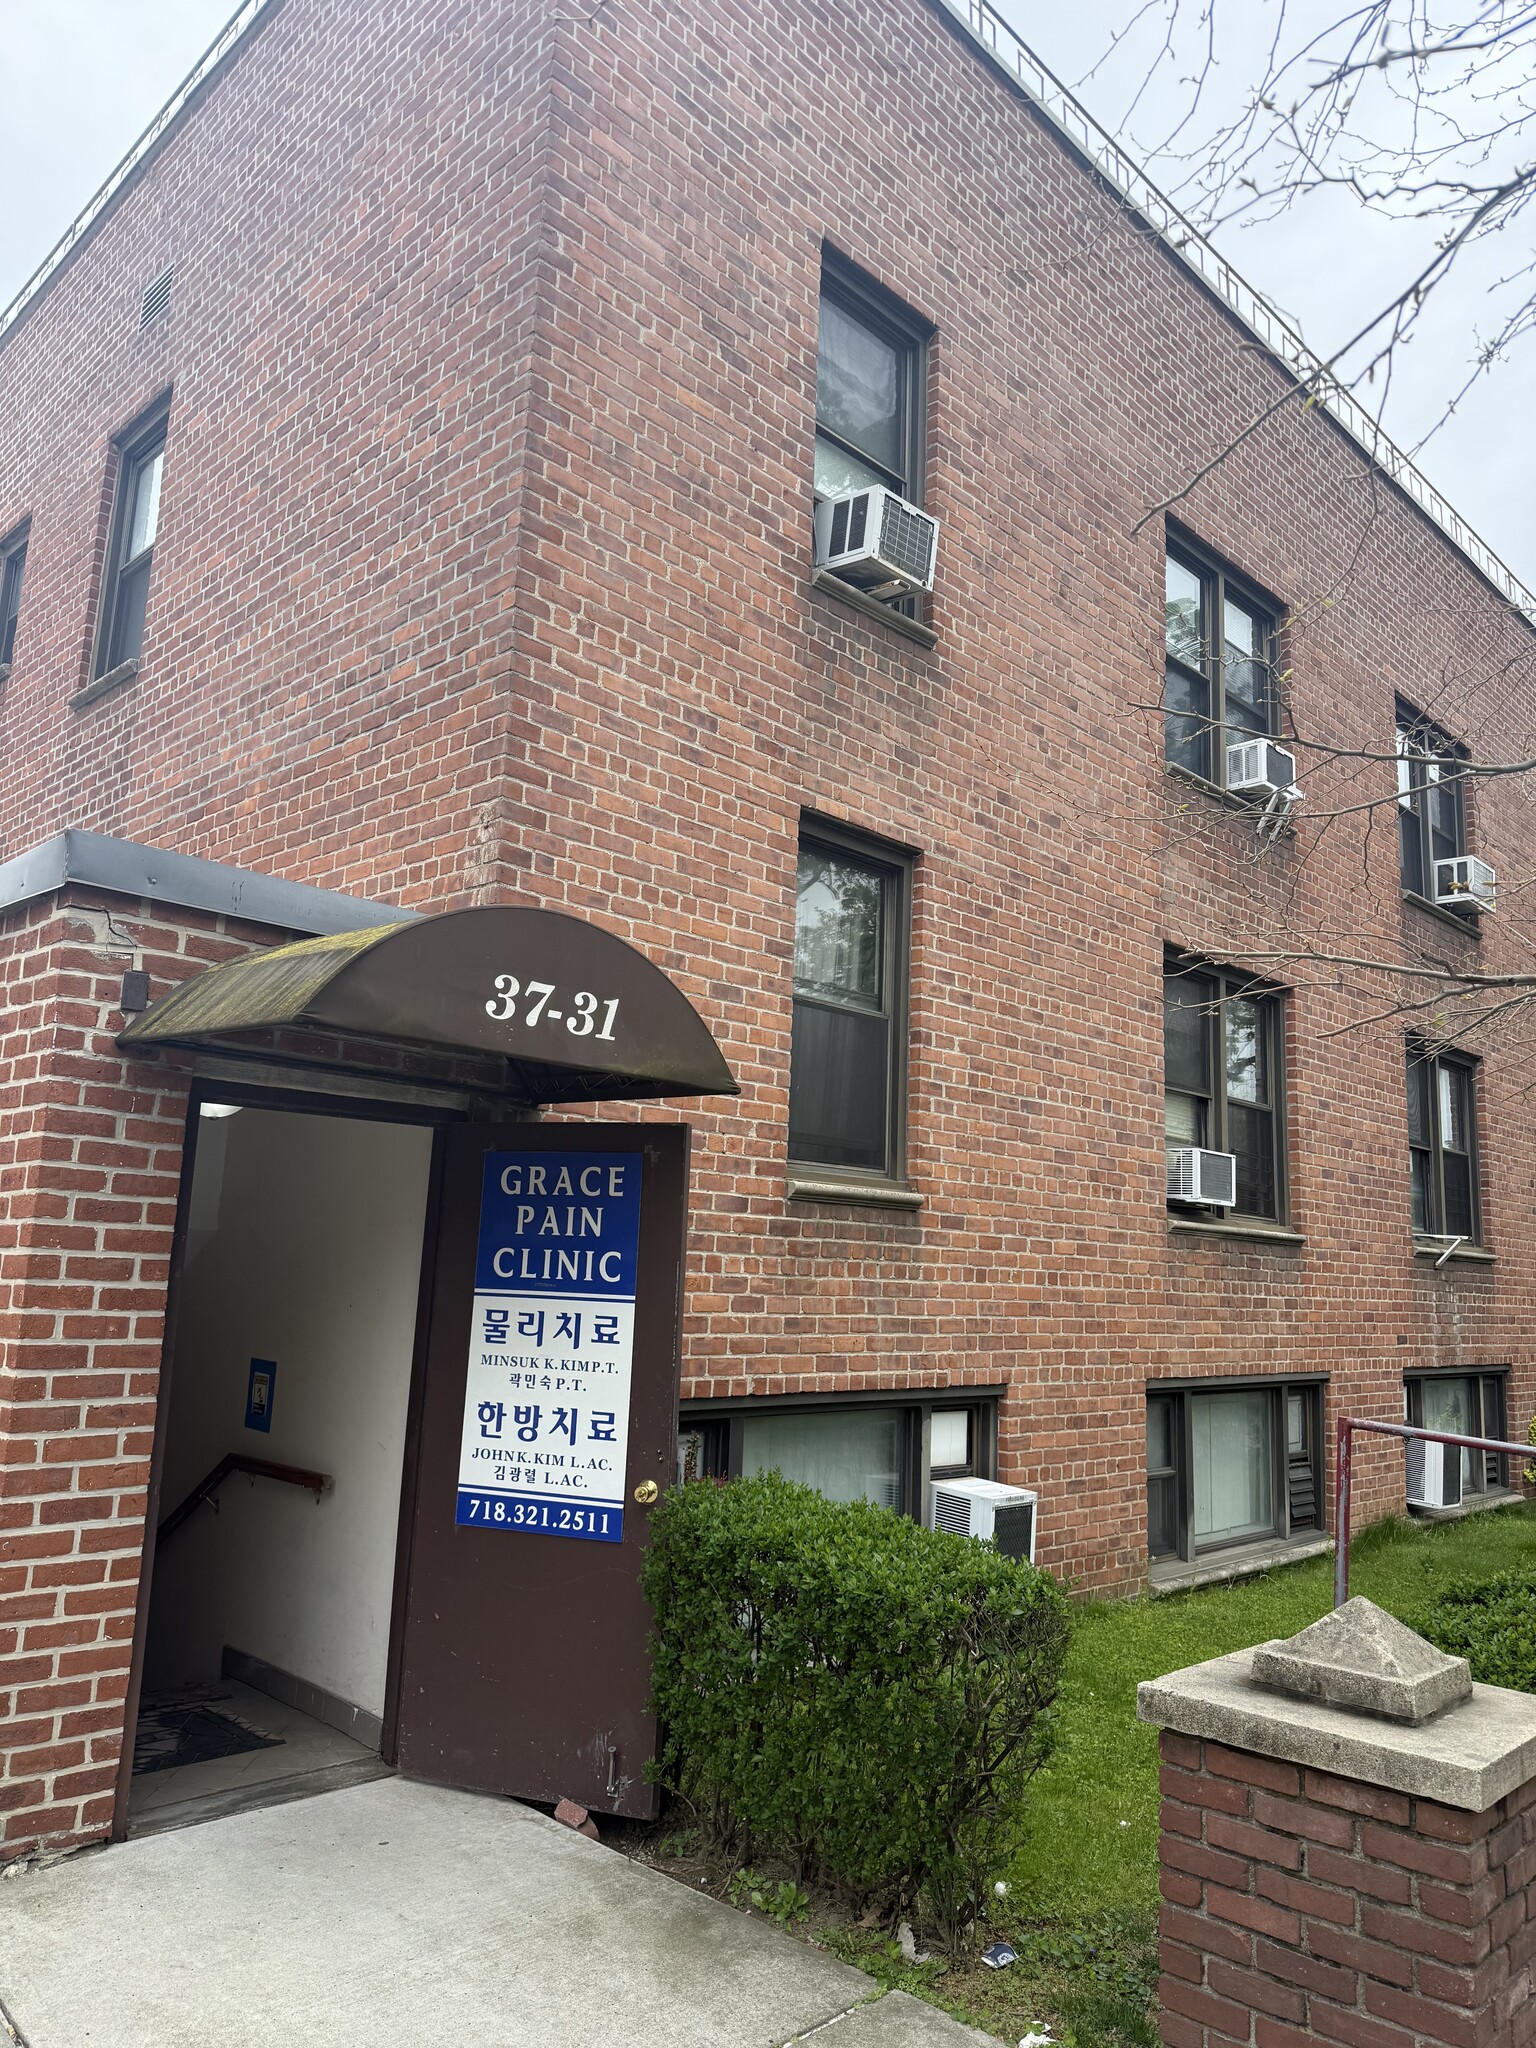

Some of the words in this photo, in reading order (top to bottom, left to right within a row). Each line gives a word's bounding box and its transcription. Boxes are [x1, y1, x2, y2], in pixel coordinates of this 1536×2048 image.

[485, 974, 620, 1041] 37-31
[500, 1165, 625, 1197] GRACE
[515, 1205, 604, 1237] PAIN
[493, 1247, 622, 1283] CLINIC
[482, 1308, 621, 1349] 물리치료
[480, 1354, 540, 1369] MINSUK
[509, 1373, 552, 1391] 곽민숙
[555, 1378, 587, 1392] P.T.
[477, 1401, 617, 1446] 한방치료
[471, 1447, 515, 1462] JOHN
[570, 1456, 613, 1471] L.AC.
[544, 1472, 588, 1488] L.AC.
[469, 1499, 609, 1534] 718.321.2511
